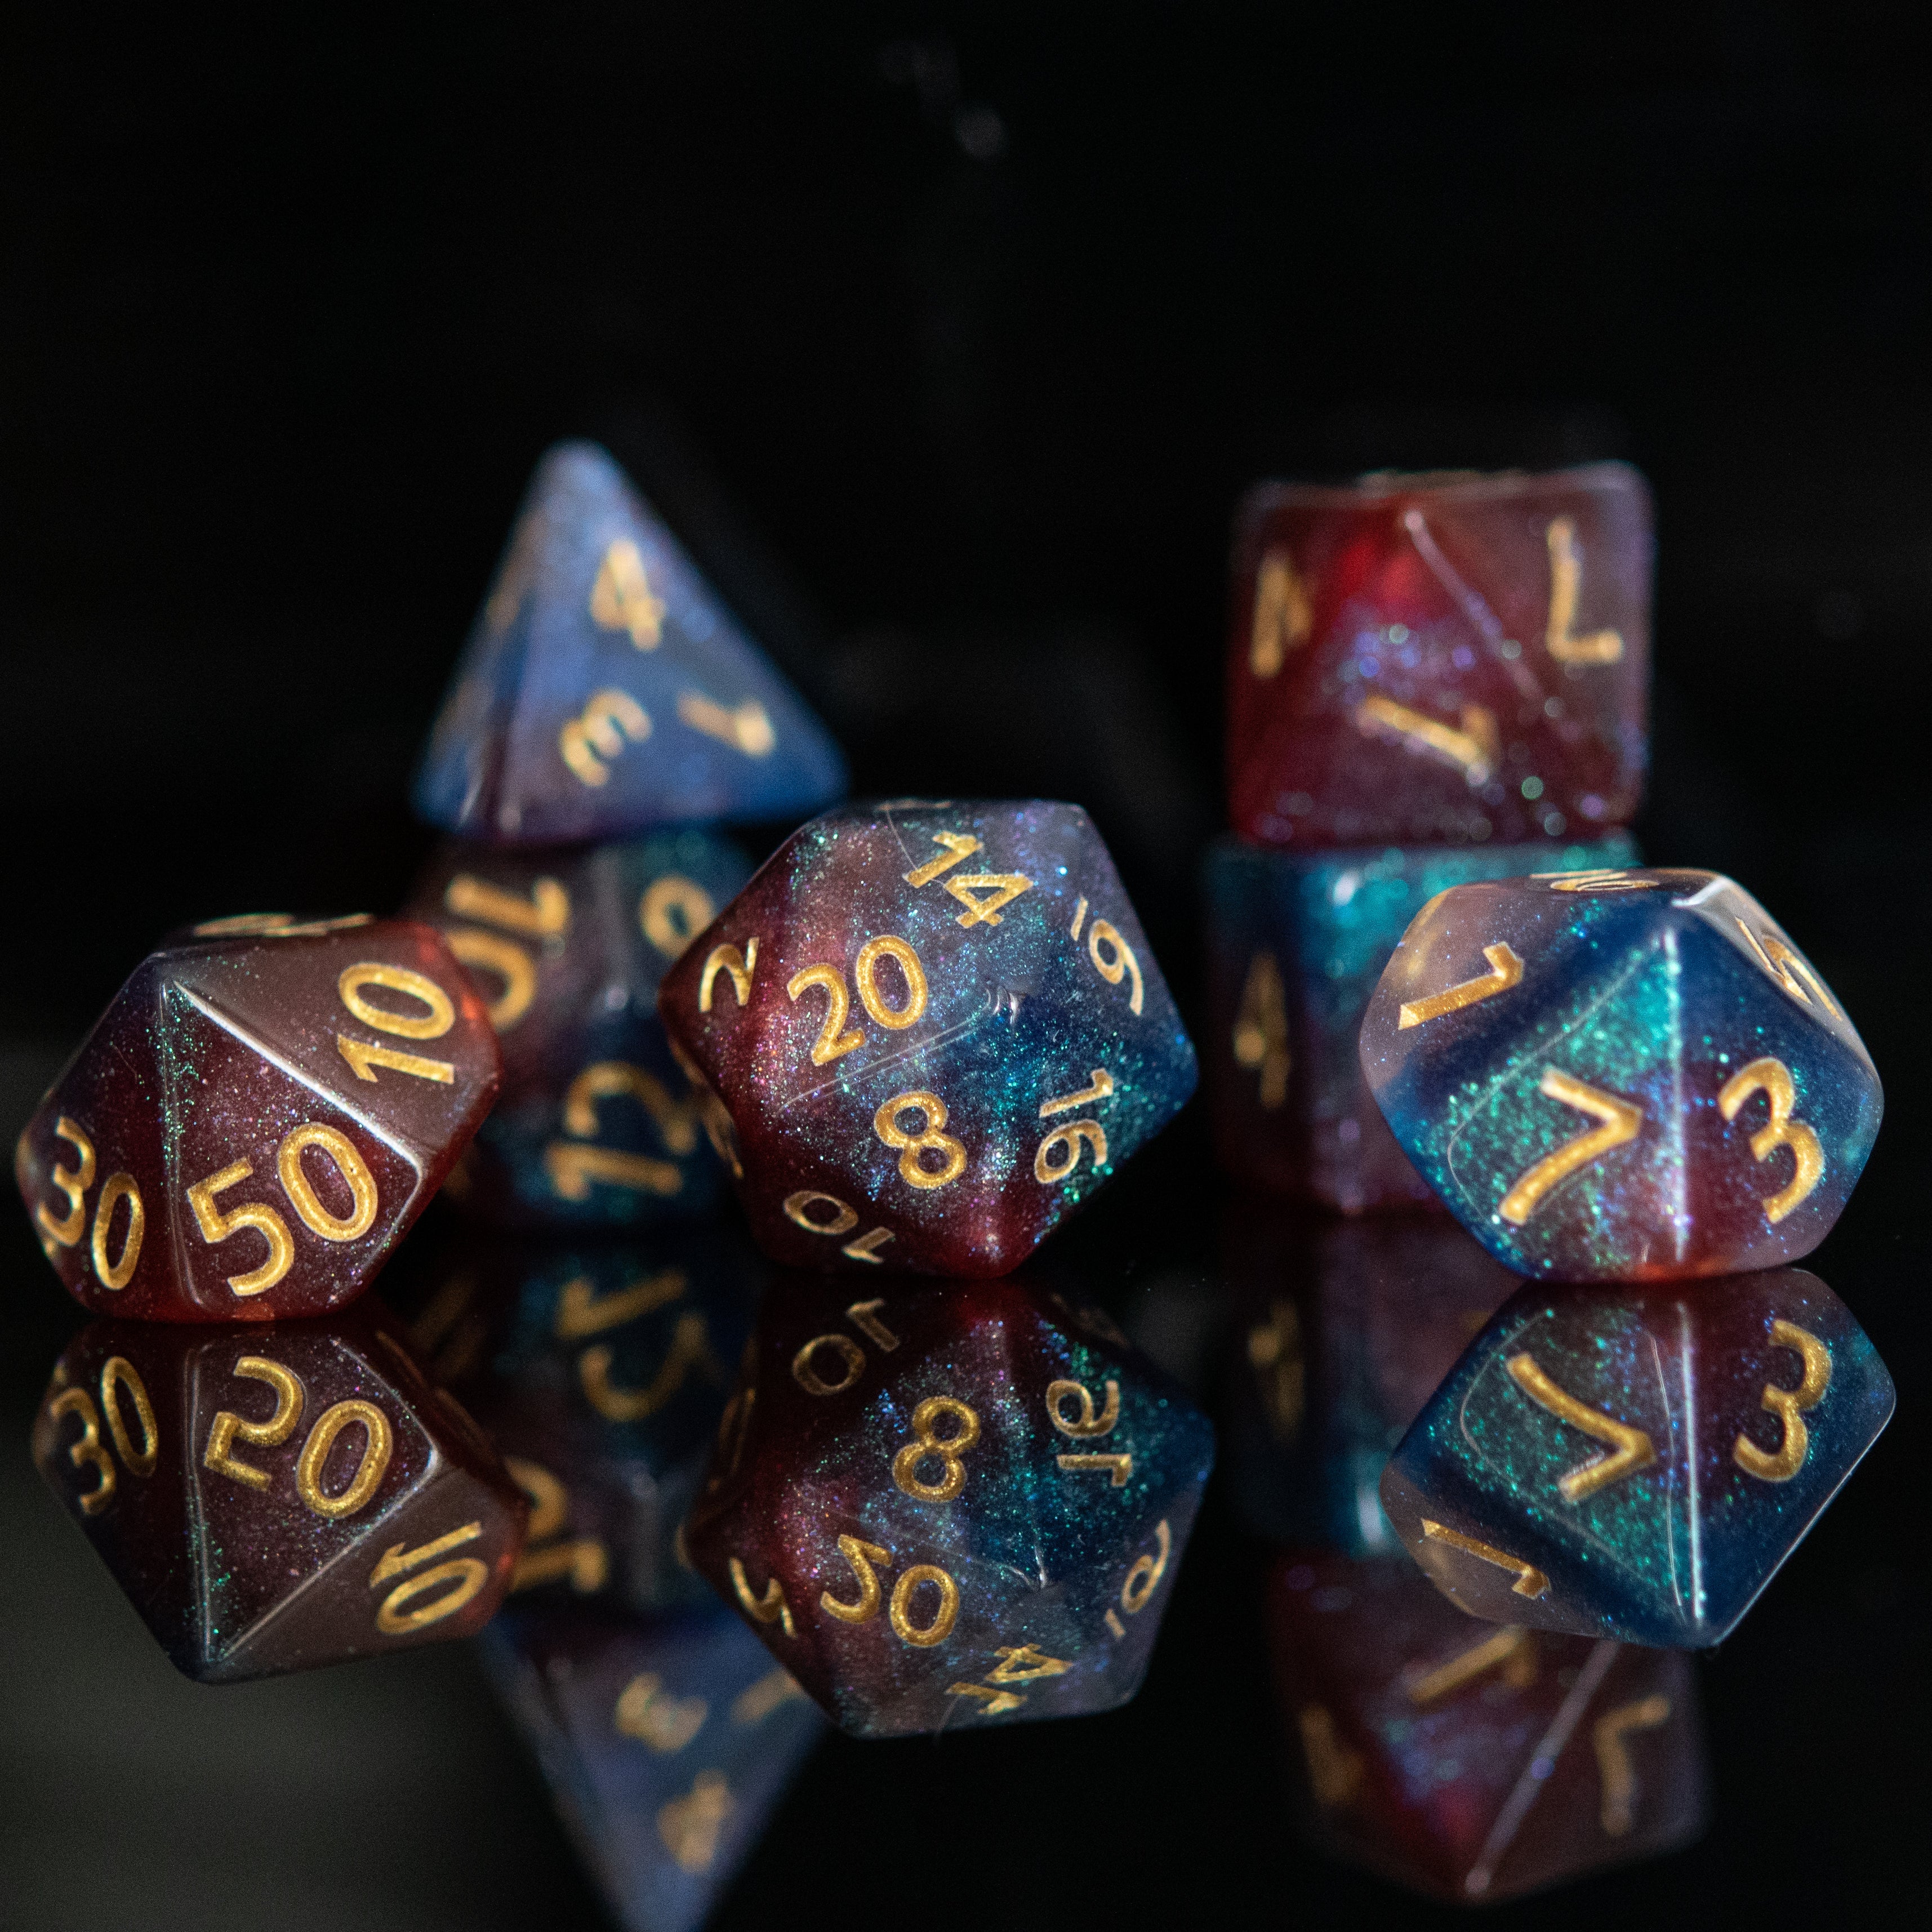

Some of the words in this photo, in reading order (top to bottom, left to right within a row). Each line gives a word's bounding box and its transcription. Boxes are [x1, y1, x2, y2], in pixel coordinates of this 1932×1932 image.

[590, 538, 667, 652] 4
[904, 830, 1034, 928] 14
[339, 962, 454, 1084] 10
[788, 934, 928, 1066] 20
[1398, 942, 1524, 1030] 1
[874, 1090, 968, 1190] 8
[1034, 1067, 1114, 1185] 16
[1498, 1065, 1644, 1226] 7
[1718, 1057, 1825, 1223] 3
[35, 1116, 145, 1292] 30
[186, 1121, 379, 1297] 50
[782, 1190, 896, 1265] 10
